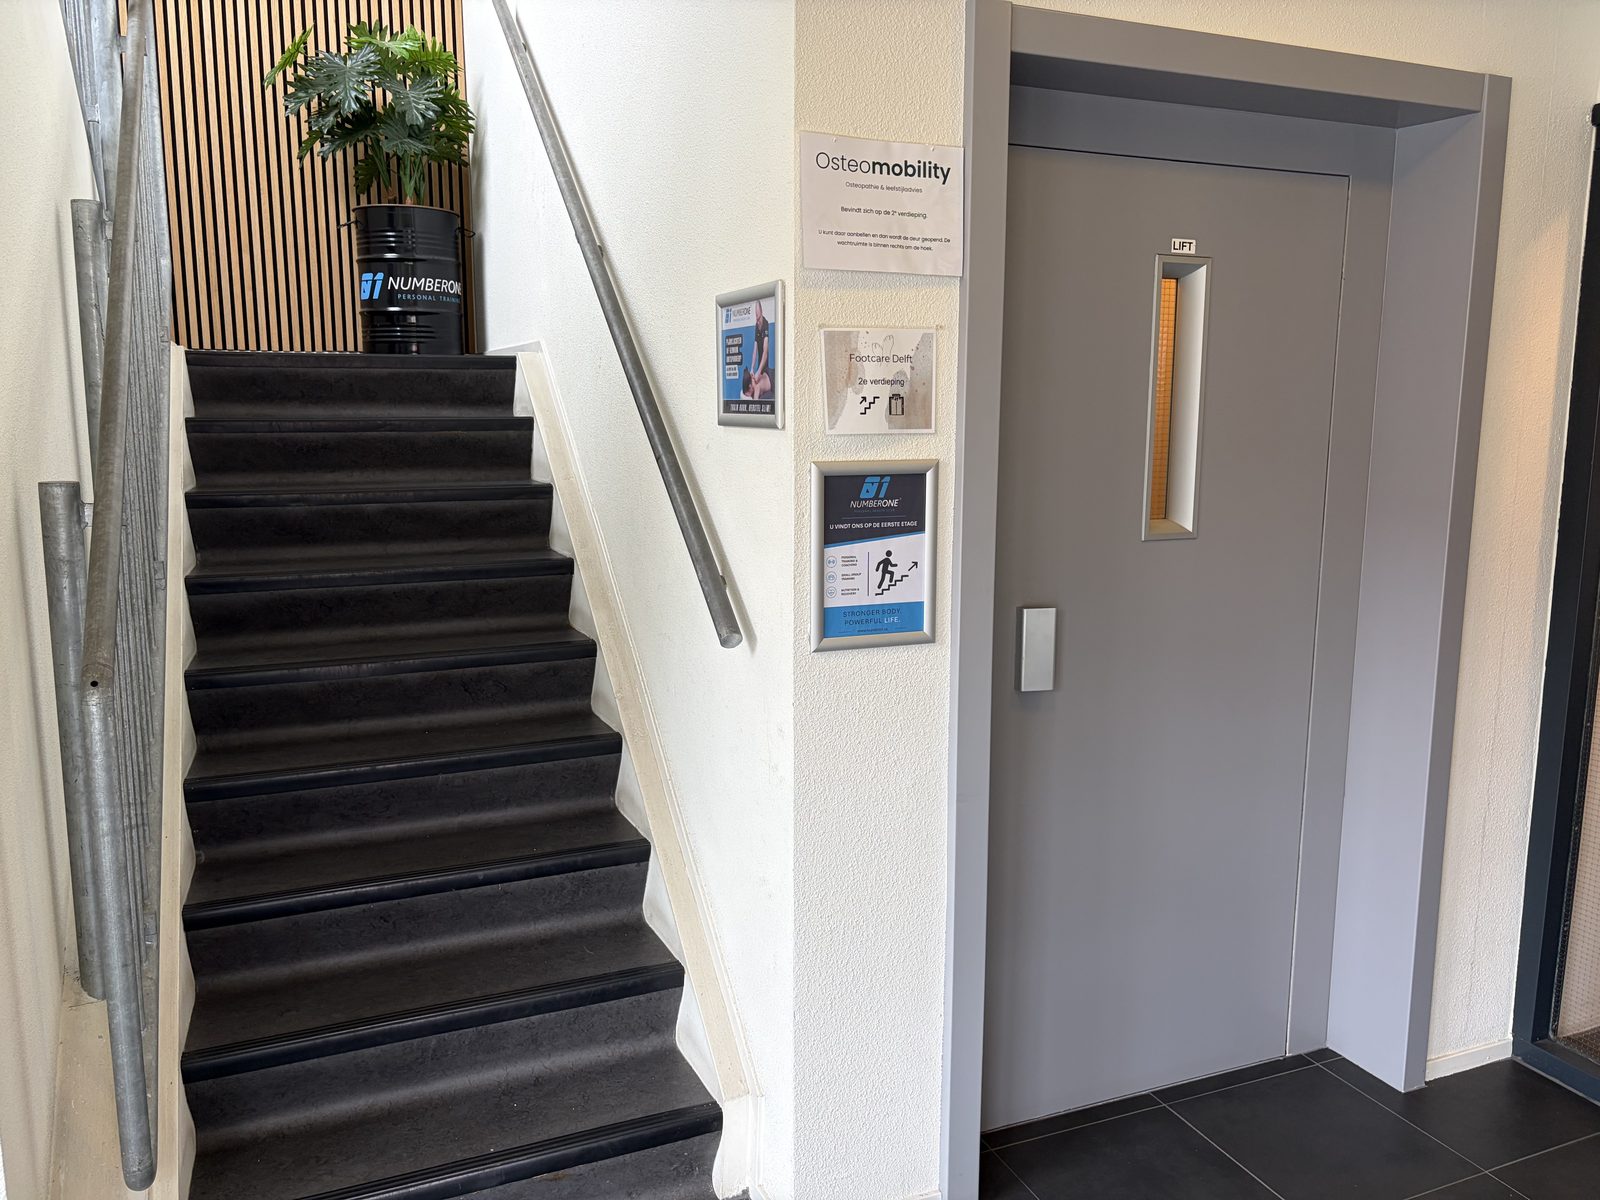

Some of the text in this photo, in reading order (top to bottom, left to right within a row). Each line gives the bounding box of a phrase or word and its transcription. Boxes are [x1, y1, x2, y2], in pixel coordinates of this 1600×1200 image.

[815, 152, 951, 185] Osteomobility
[845, 181, 880, 190] Osteopathie
[898, 211, 928, 220] verdieping.
[1172, 240, 1194, 251] LIFT
[849, 353, 913, 364] Footcare Delft
[870, 378, 905, 387] verdieping
[850, 499, 900, 508] NUMBERONE
[842, 609, 880, 618] STRONGER
[844, 618, 883, 626] POWERFUL
